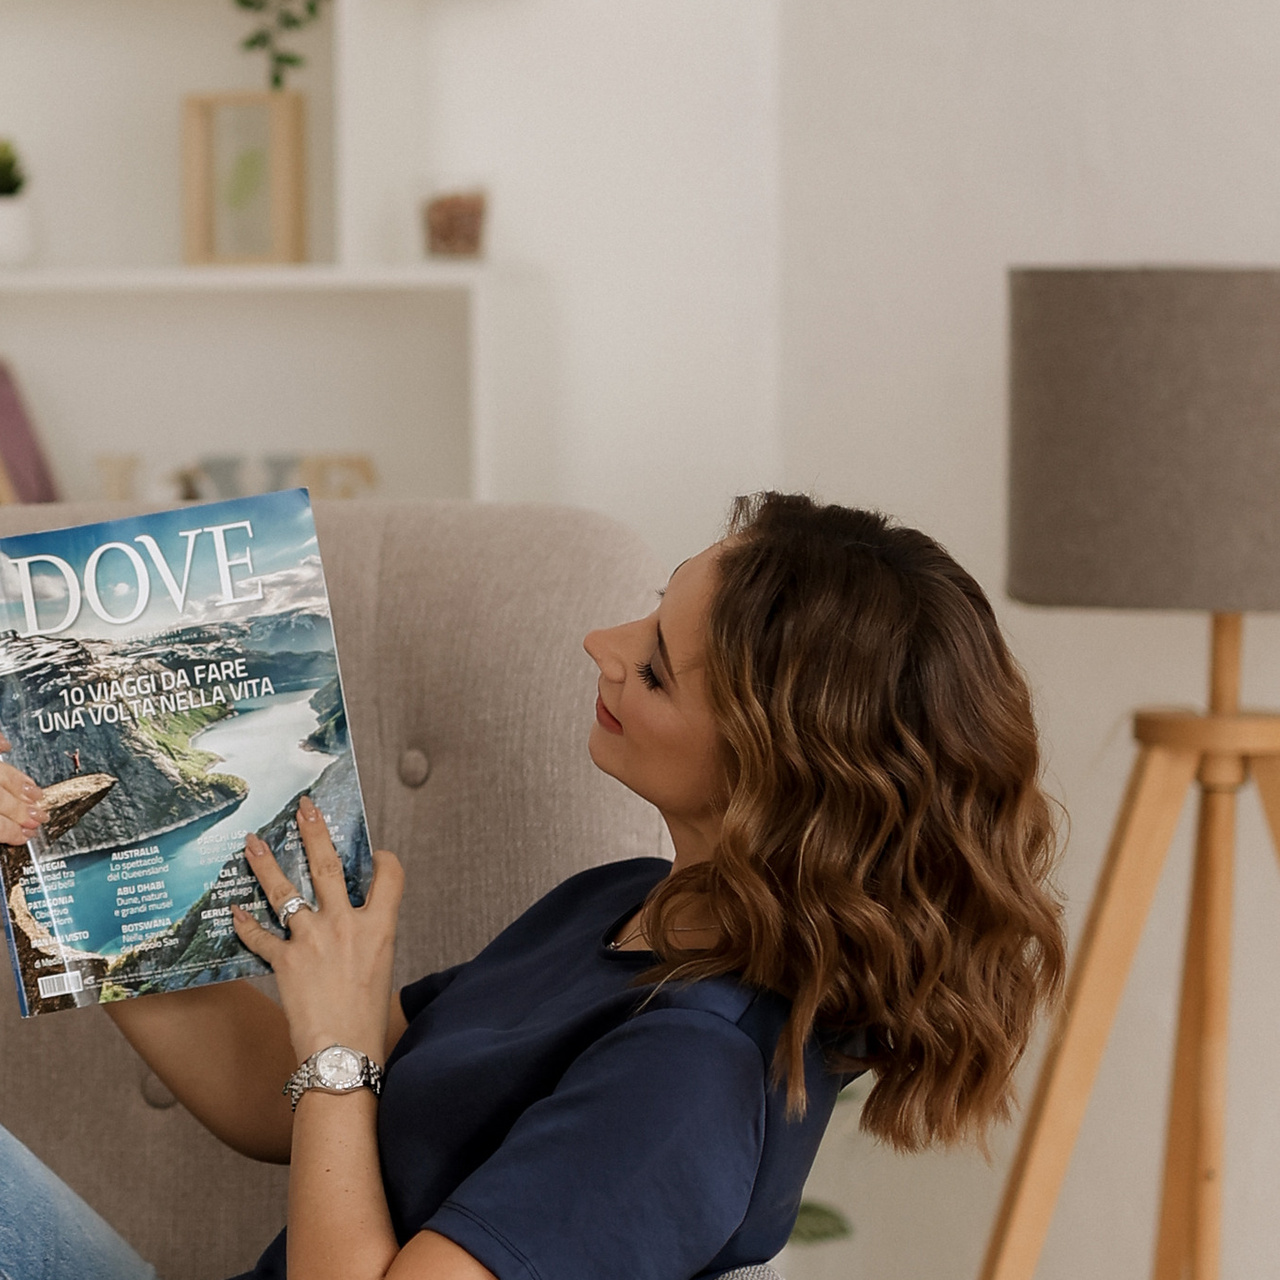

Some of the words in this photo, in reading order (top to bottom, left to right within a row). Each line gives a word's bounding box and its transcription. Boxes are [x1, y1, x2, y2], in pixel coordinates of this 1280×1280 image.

[8, 520, 263, 638] DOVE
[59, 687, 85, 707] 10
[87, 674, 156, 703] VIAGGI
[160, 669, 192, 690] DA
[194, 658, 249, 685] FARE
[38, 709, 86, 734] UNA
[88, 697, 156, 726] VOLTA
[159, 686, 226, 713] NELLA
[229, 676, 275, 701] VITA
[111, 845, 160, 861] AUSTRALIA
[23, 860, 67, 875] NOVEGIA
[110, 863, 121, 871] Lo
[122, 856, 164, 870] spettacolo
[62, 870, 75, 879] tra
[107, 872, 119, 882] del
[121, 864, 169, 880] Queensland
[220, 867, 238, 878] CILE
[117, 885, 135, 896] ABU
[137, 880, 165, 892] DHABI
[211, 891, 217, 900] a
[218, 886, 252, 899] Santiago
[141, 891, 168, 902] natura
[114, 909, 120, 917] e
[121, 905, 147, 918] grandi
[148, 899, 173, 911] musei
[201, 900, 267, 920] GERUSEMME
[121, 918, 172, 933] BOTSWANA
[65, 931, 89, 942] VISTO
[162, 936, 179, 946] San
